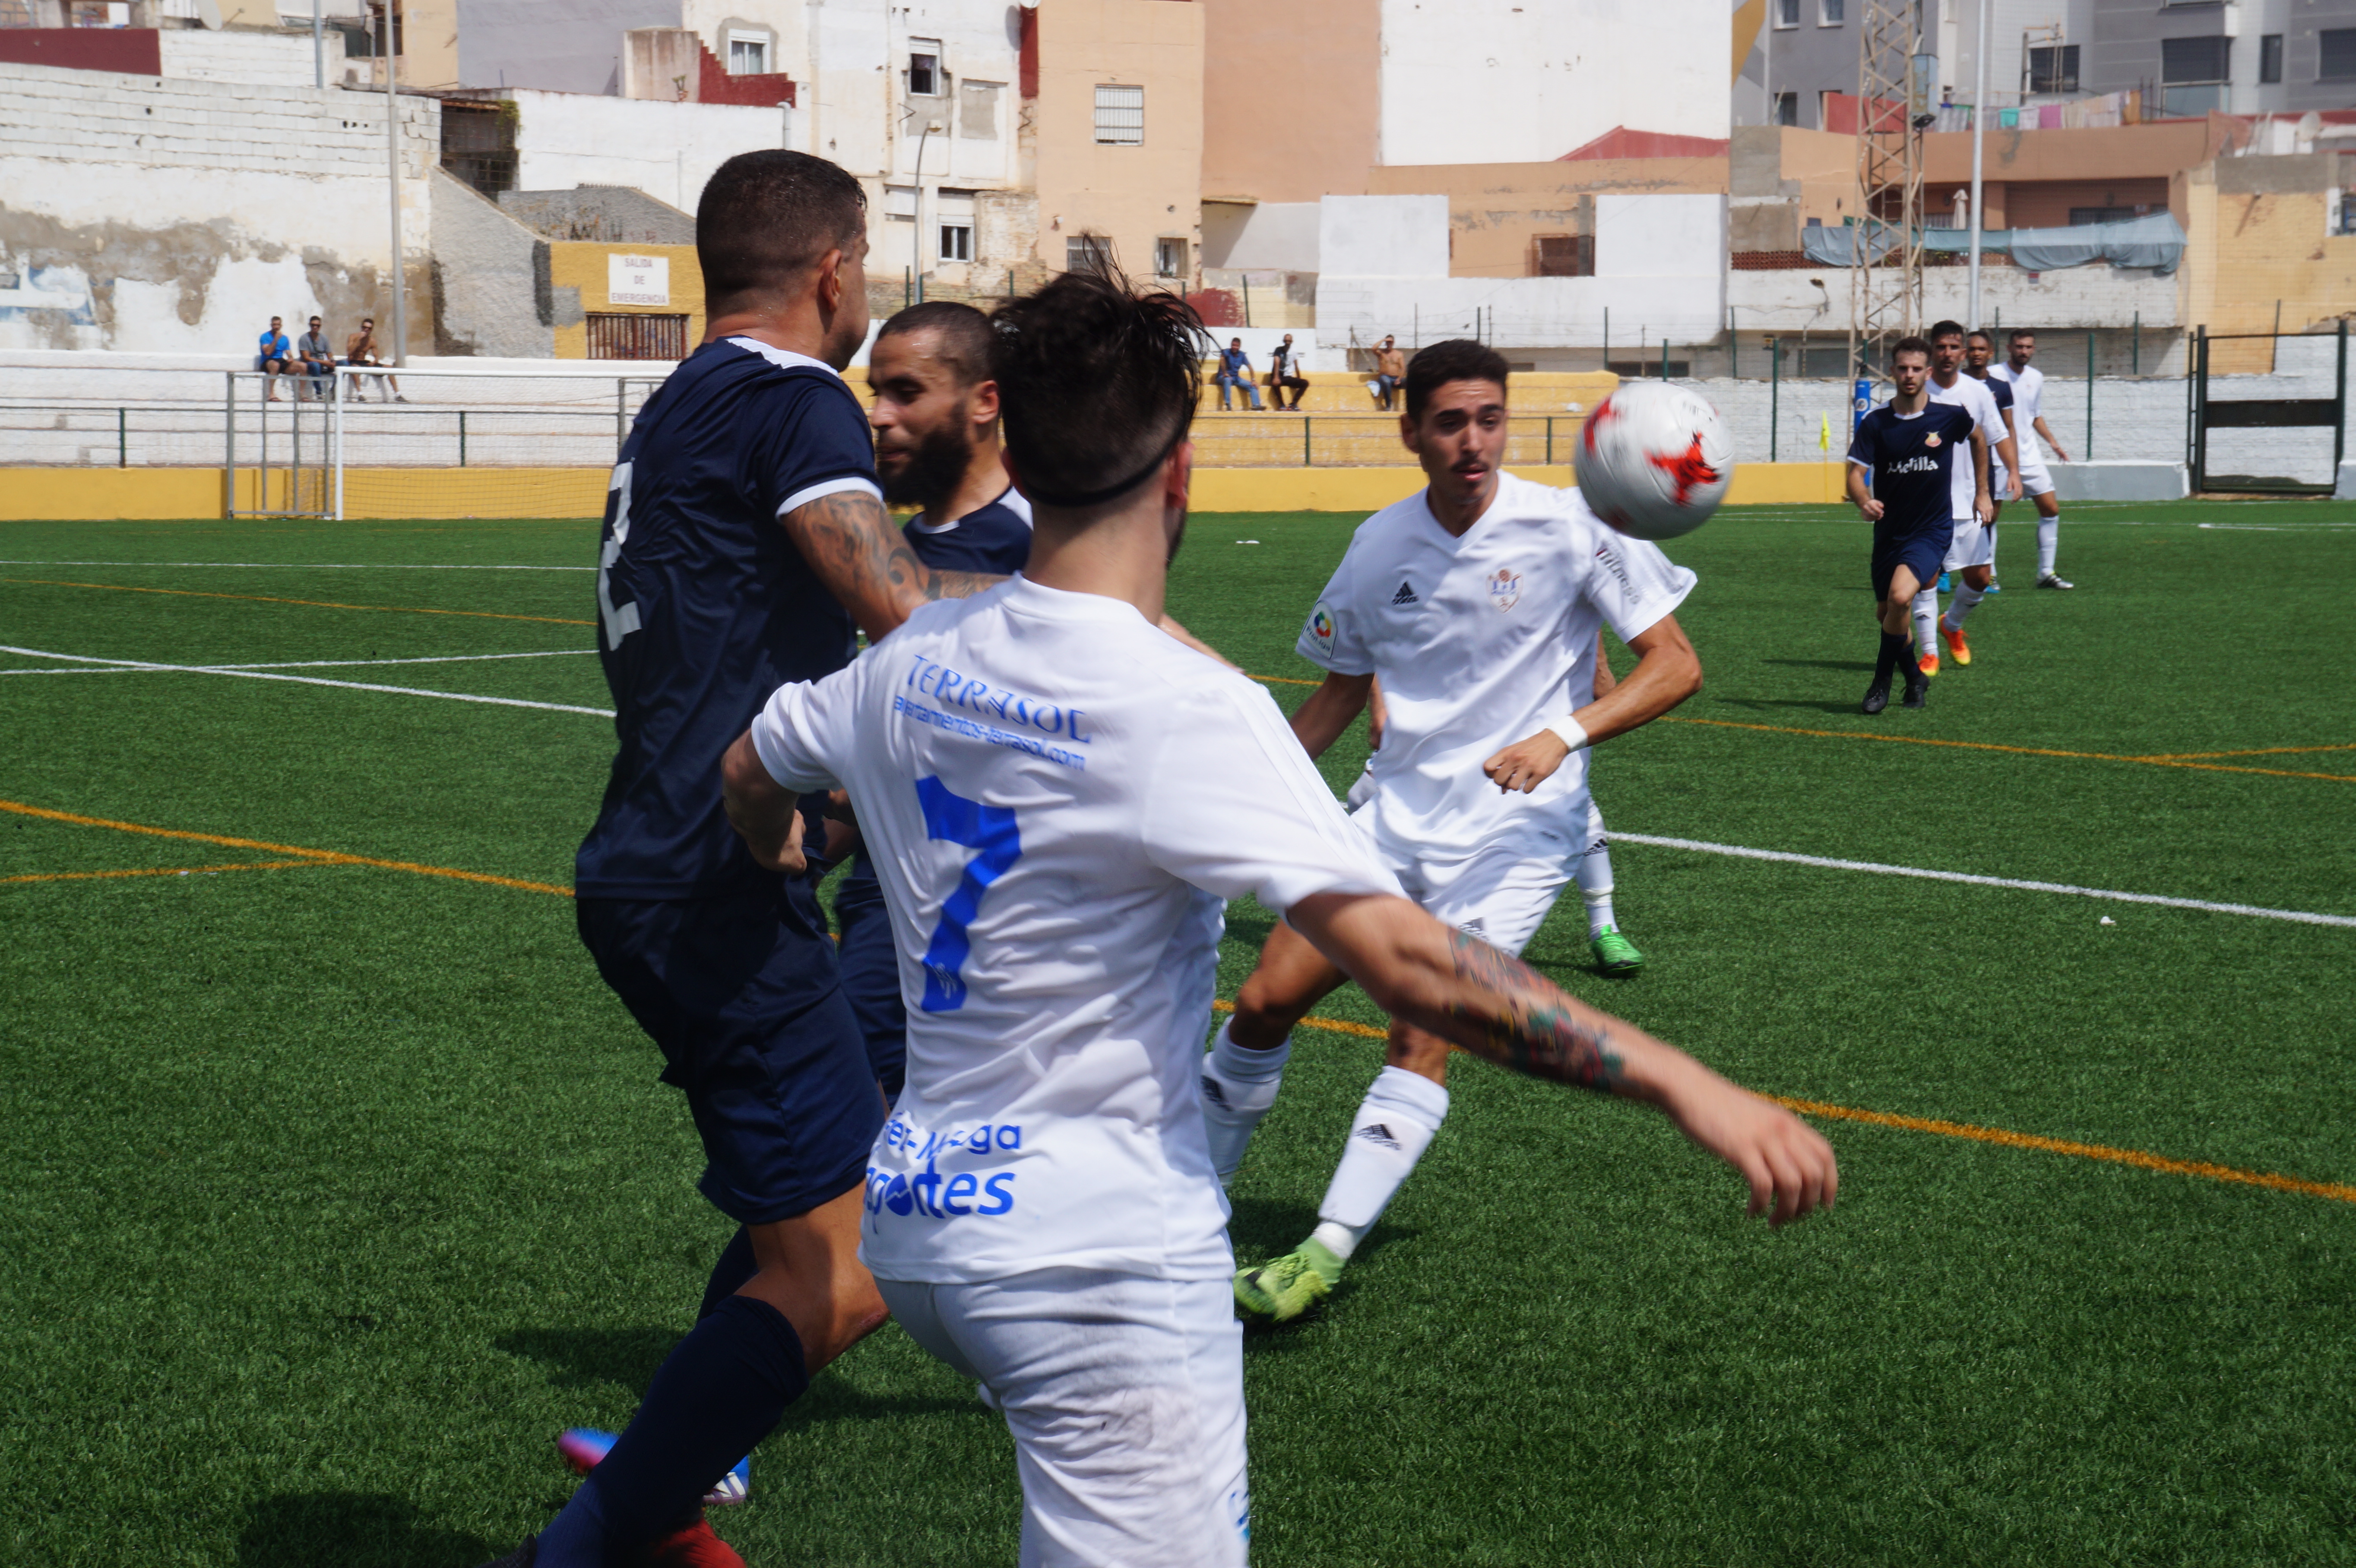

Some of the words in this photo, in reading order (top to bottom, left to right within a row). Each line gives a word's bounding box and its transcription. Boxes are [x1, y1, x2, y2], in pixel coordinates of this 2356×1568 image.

[625, 258, 652, 268] SALIDA
[634, 275, 645, 285] DE
[611, 294, 666, 303] EMERGENCIA
[908, 654, 1092, 744] TERRASOL
[914, 774, 1024, 1012] 7
